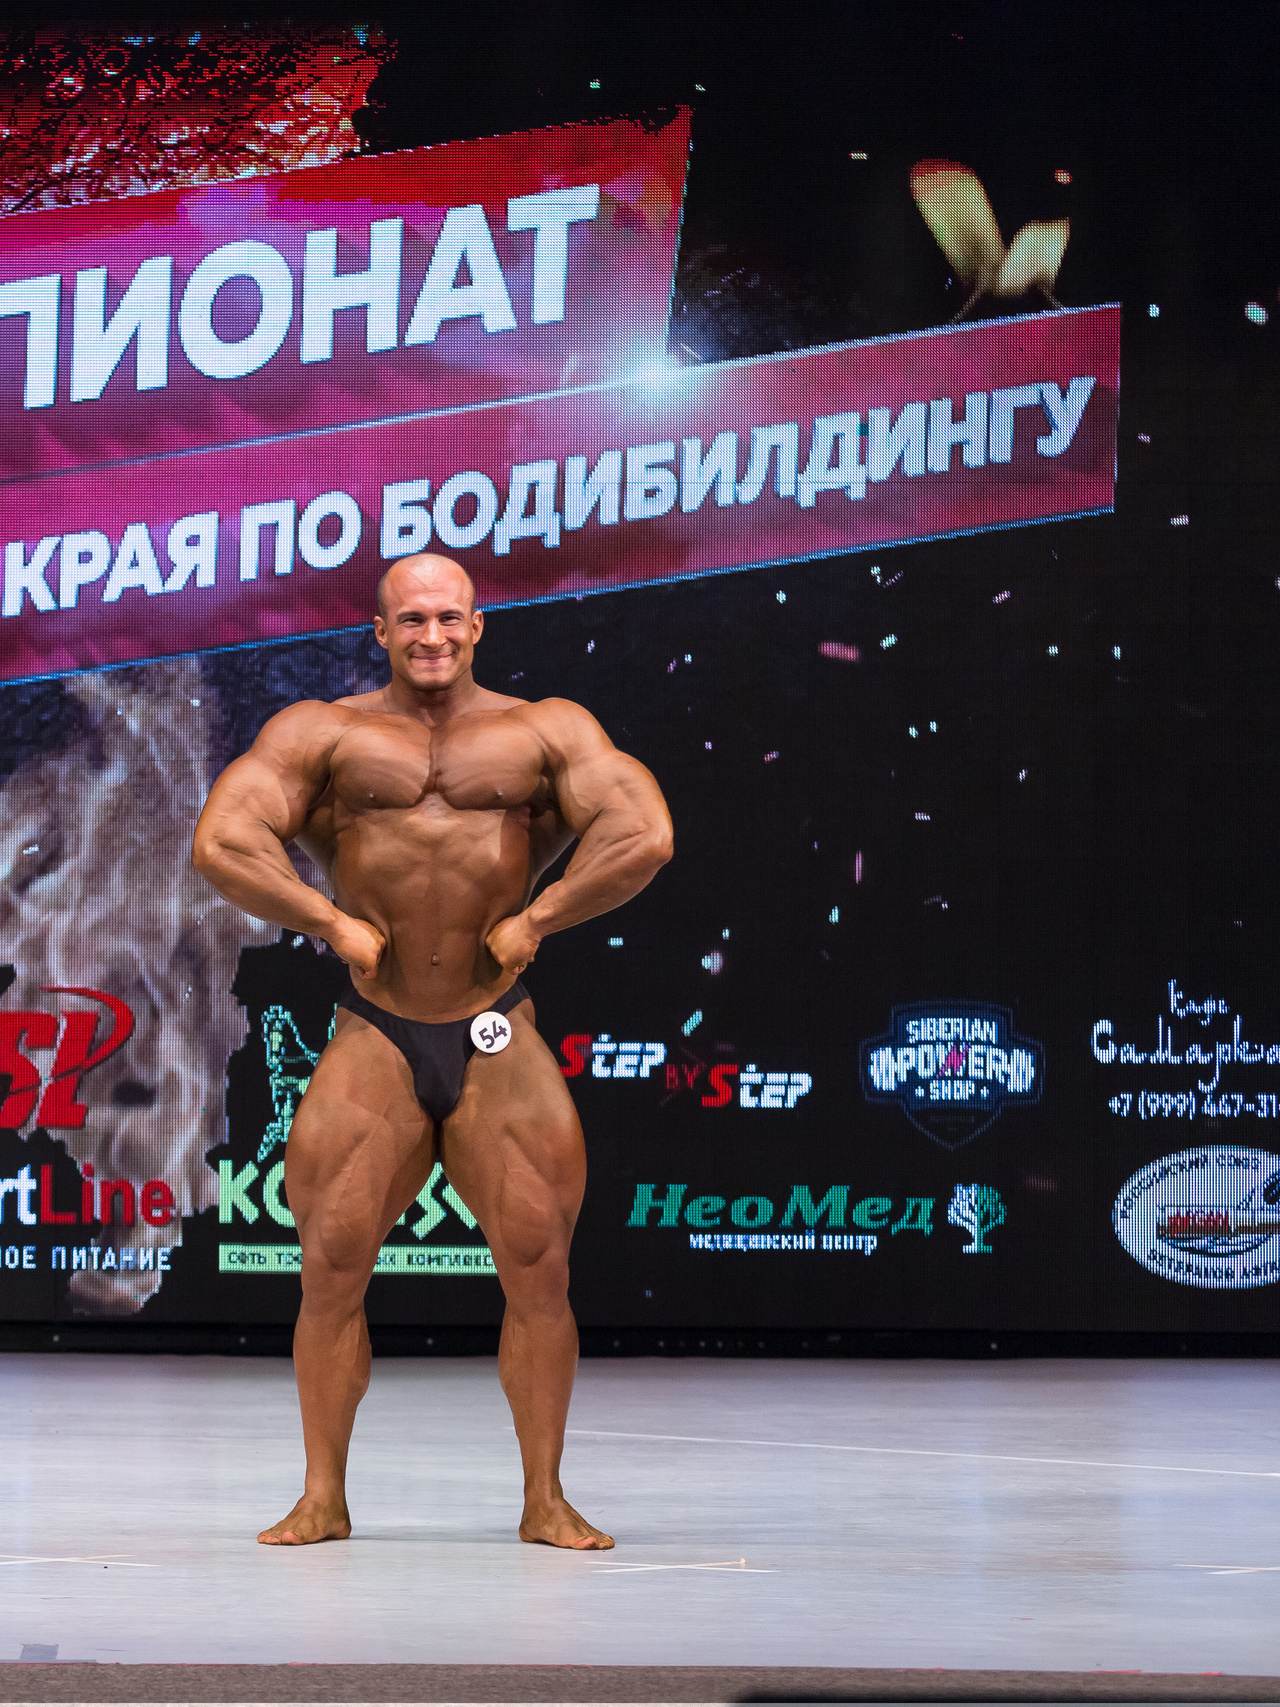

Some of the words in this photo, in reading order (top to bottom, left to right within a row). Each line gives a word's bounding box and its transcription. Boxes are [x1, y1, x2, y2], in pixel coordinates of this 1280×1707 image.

[2, 510, 219, 618] КРАЯ
[239, 490, 363, 583] ПО
[379, 376, 1096, 560] БОДИБИЛДИНГУ
[478, 1020, 508, 1049] 54
[906, 1017, 999, 1044] SIBERIAN
[896, 1042, 1005, 1085] POWER
[929, 1079, 976, 1101] SHOP
[1108, 1091, 1133, 1118] +7
[625, 1183, 936, 1238] НеоМед
[51, 1246, 172, 1271] ПИТАНИЕ
